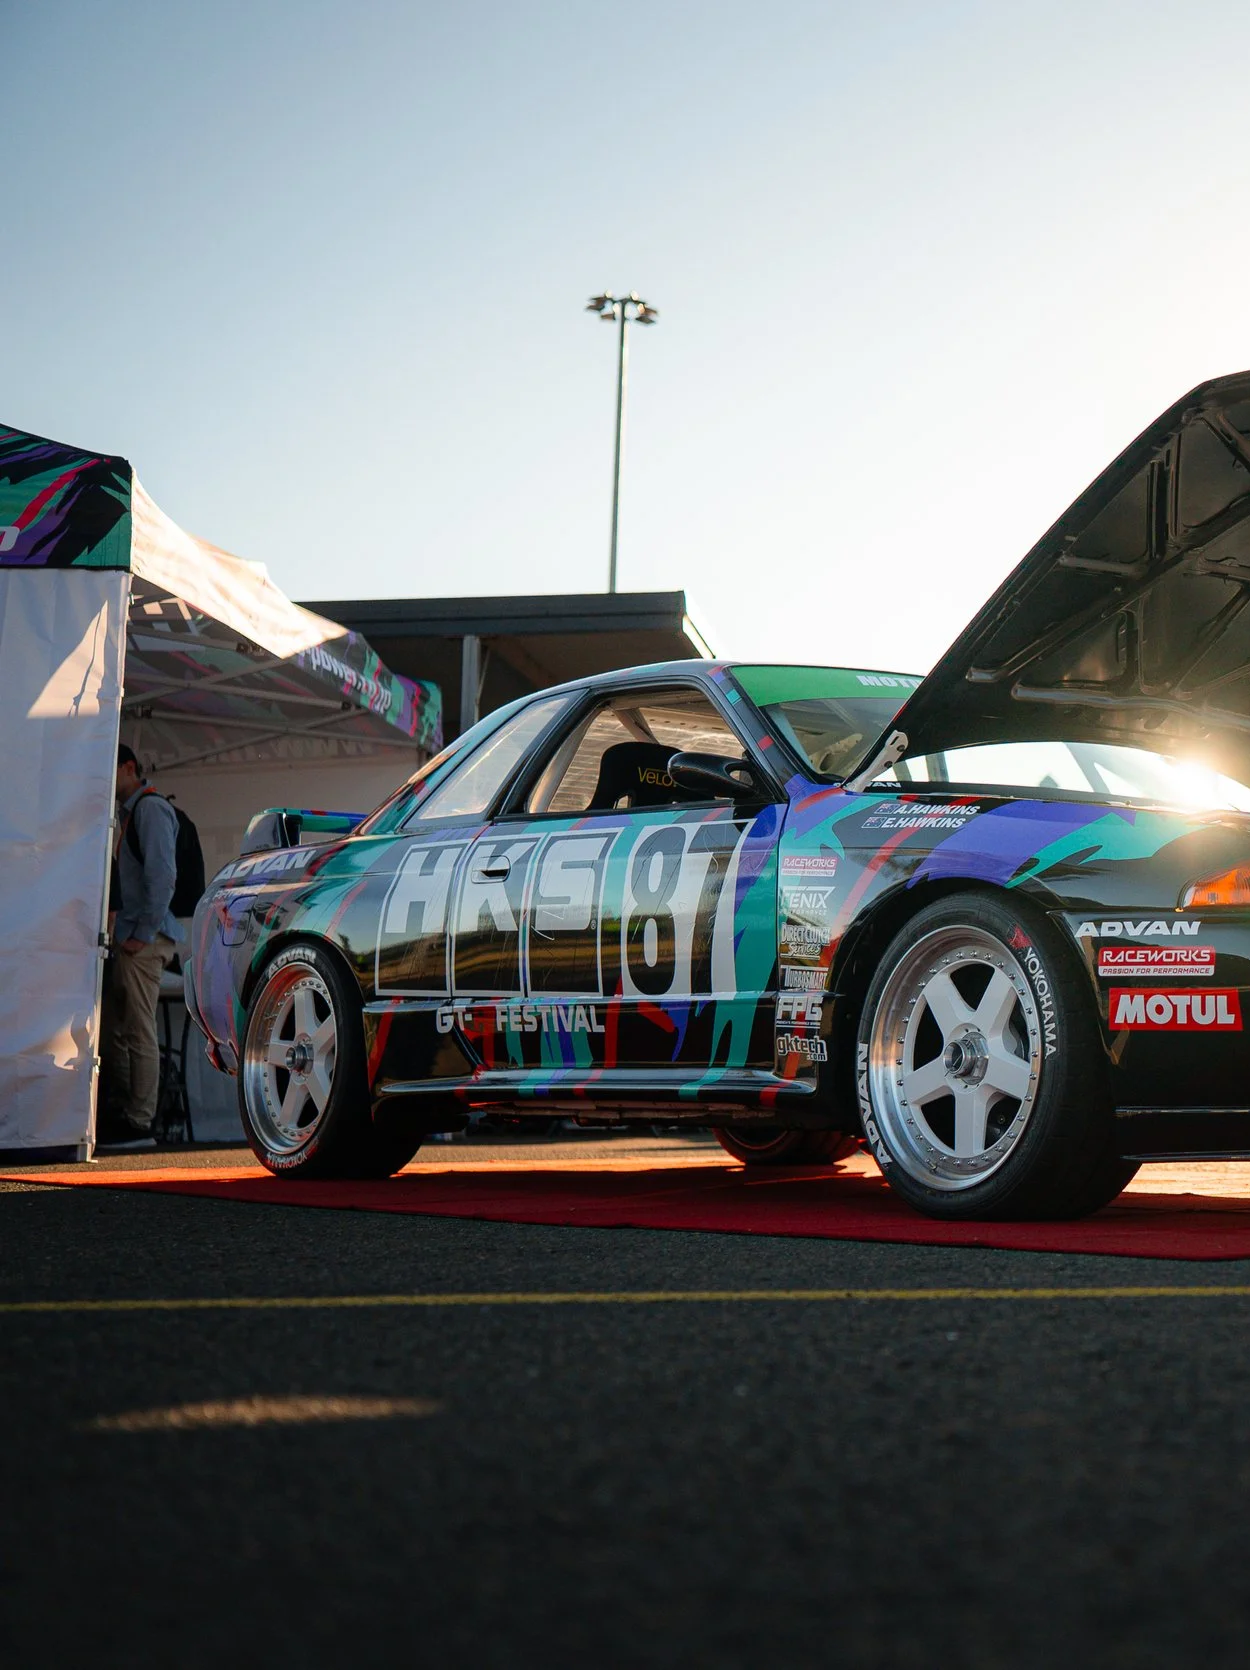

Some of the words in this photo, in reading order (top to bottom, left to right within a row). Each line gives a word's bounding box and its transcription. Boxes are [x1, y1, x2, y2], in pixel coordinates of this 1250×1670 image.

[893, 804, 981, 815] A.HAWKINS
[880, 817, 966, 828] E.HAWKINS
[213, 850, 317, 882] ADVAN
[783, 858, 837, 868] RACEWORKS
[384, 835, 609, 934] HKS
[781, 922, 804, 945] DIRECT
[1075, 921, 1201, 938] ADVAN
[1102, 950, 1211, 963] RACEWORKS
[776, 996, 824, 1021] FPG
[1024, 946, 1057, 1061] YOKOHAMA
[1114, 994, 1236, 1025] MOTUL
[495, 1004, 605, 1033] FESTIVAL
[777, 1034, 827, 1056] gktech
[857, 1042, 893, 1164] ADVAN
